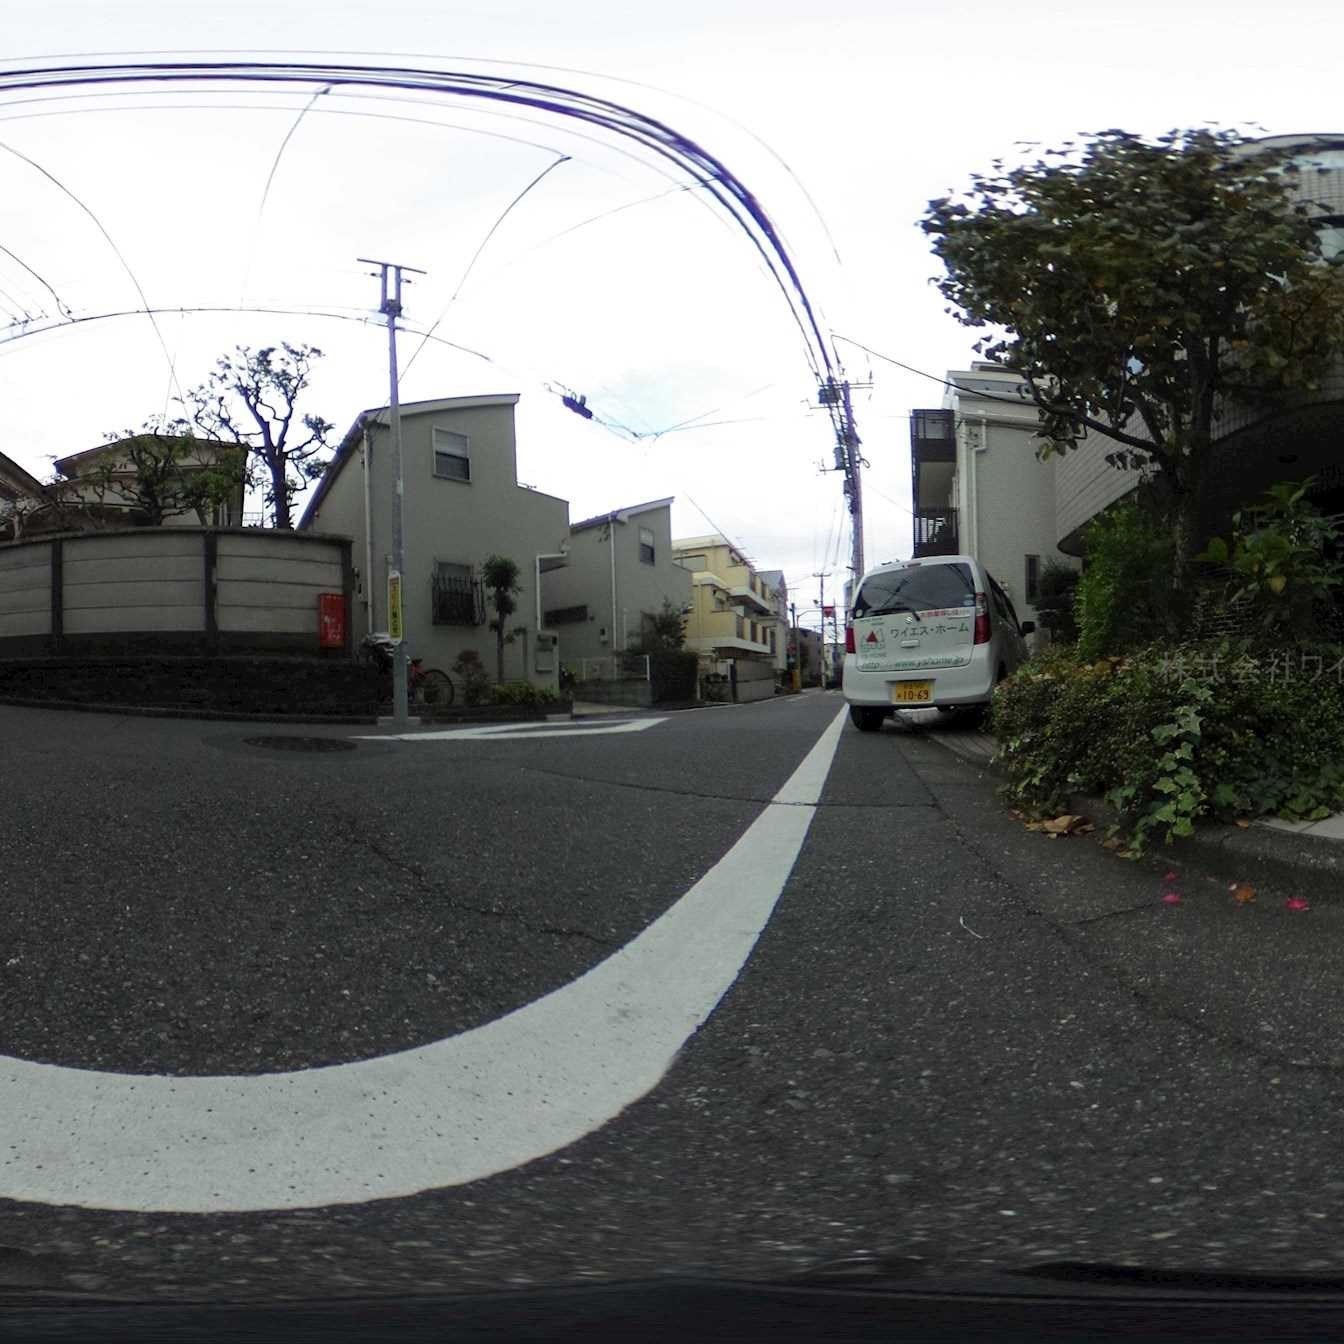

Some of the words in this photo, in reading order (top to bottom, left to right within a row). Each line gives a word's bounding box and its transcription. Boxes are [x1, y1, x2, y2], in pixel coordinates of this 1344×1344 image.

[890, 622, 969, 639] ワイエス・ホーム
